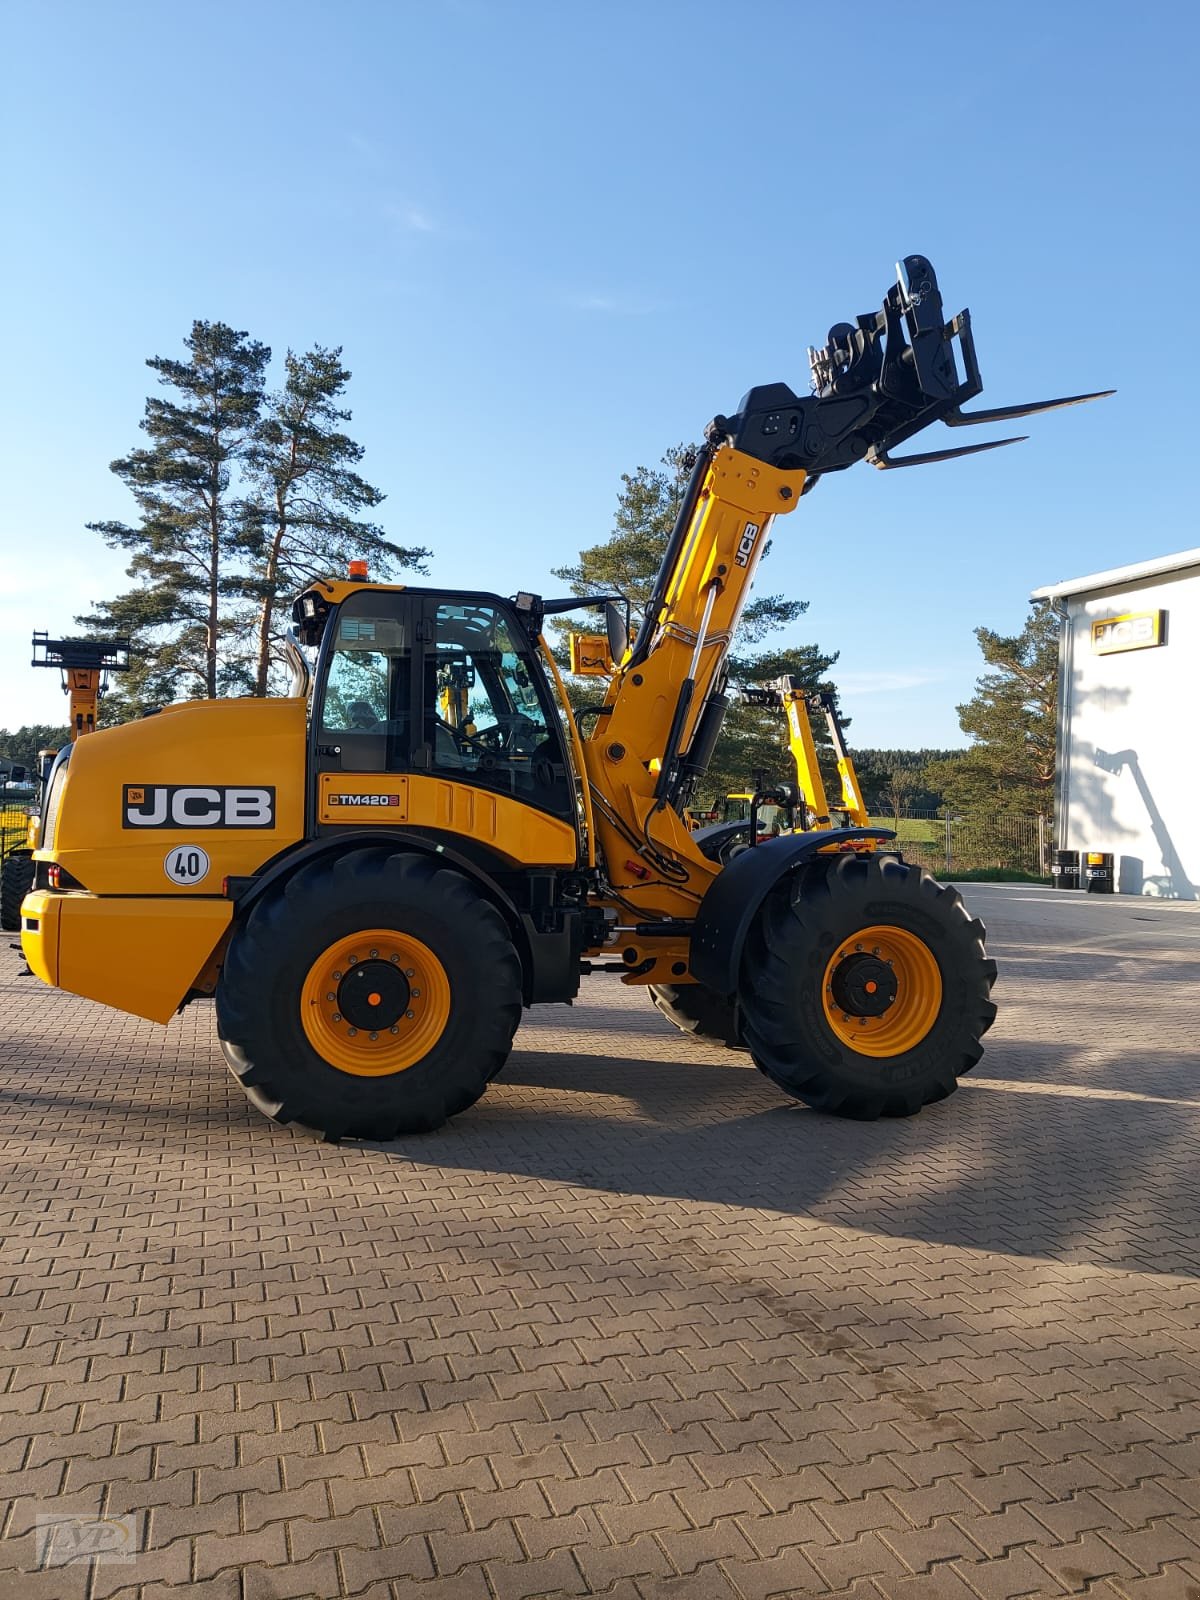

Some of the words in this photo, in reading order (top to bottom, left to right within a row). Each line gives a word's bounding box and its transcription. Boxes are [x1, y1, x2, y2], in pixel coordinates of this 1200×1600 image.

[735, 523, 758, 567] JCB
[1096, 617, 1153, 648] JCB
[127, 788, 272, 826] JCB
[174, 852, 200, 877] 40
